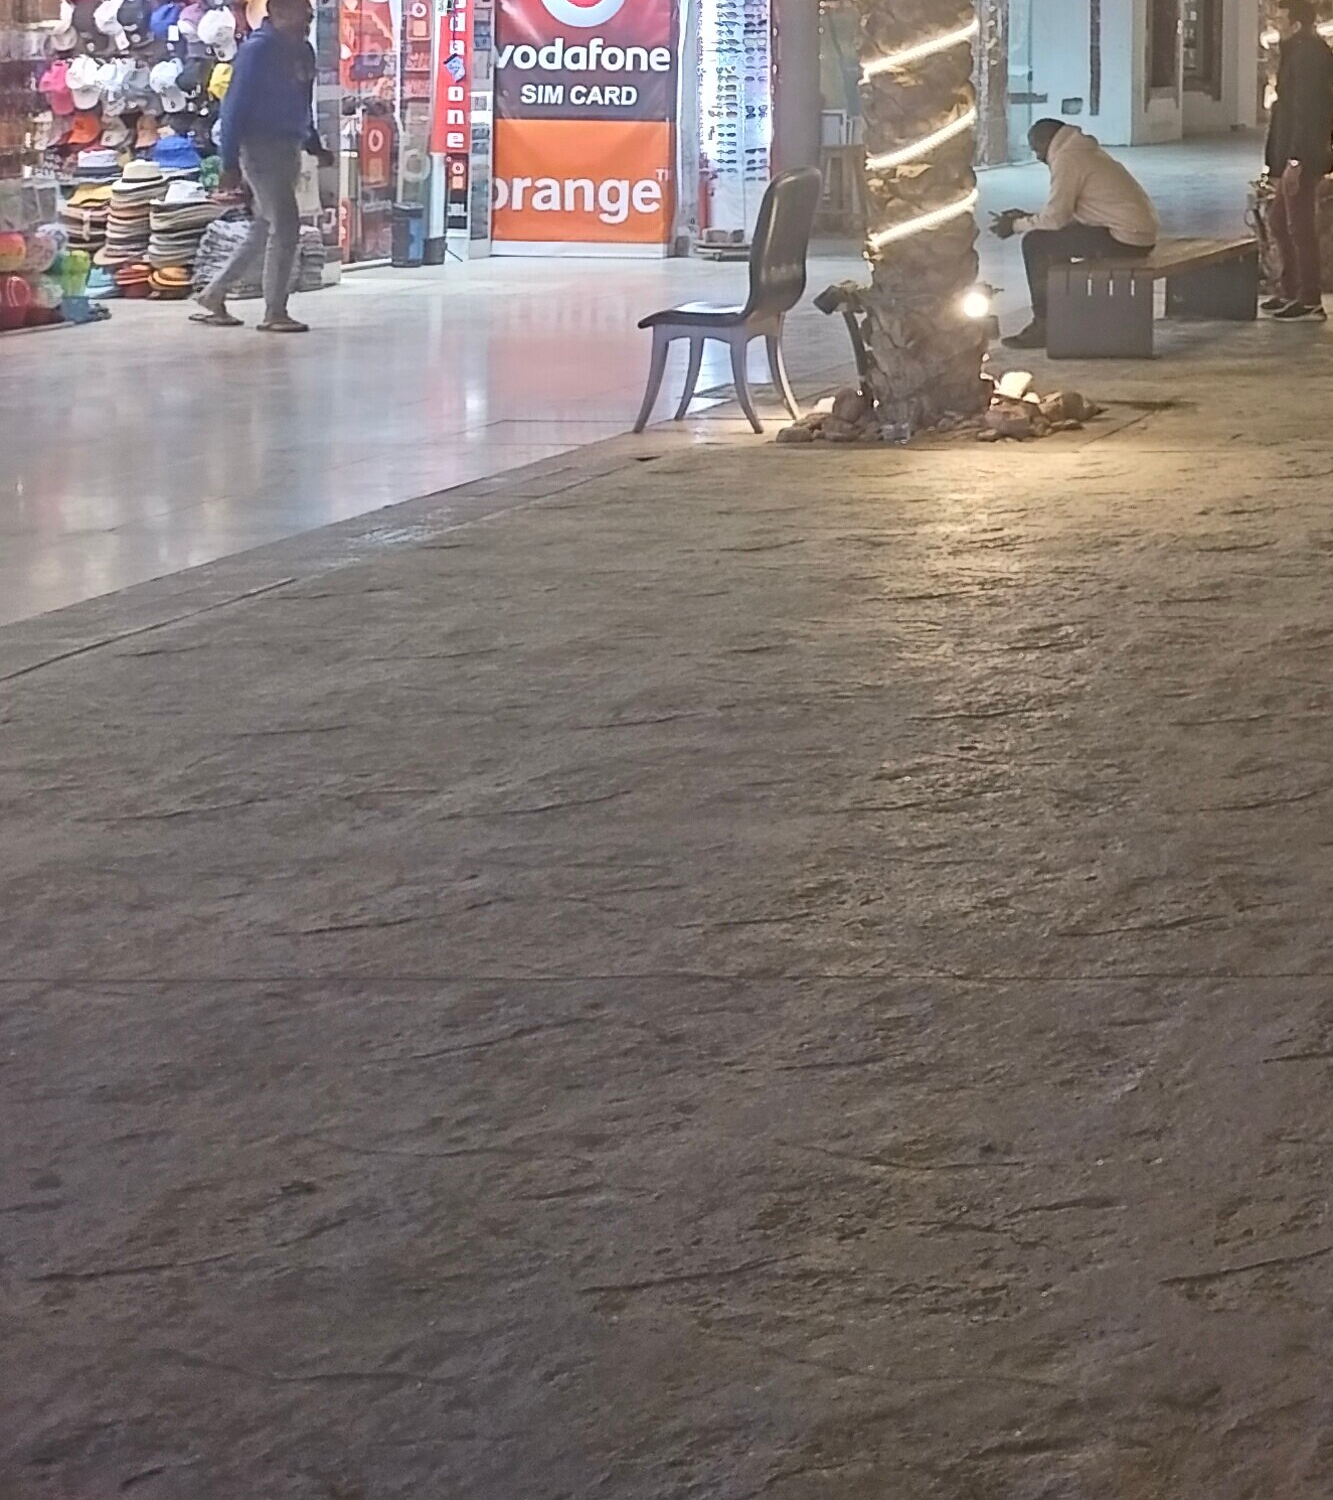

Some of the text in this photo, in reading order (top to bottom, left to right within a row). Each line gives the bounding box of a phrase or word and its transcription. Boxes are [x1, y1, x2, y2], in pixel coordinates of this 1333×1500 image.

[497, 37, 671, 71] vodafone
[520, 84, 638, 106] SIM CARD
[492, 174, 662, 224] orange
